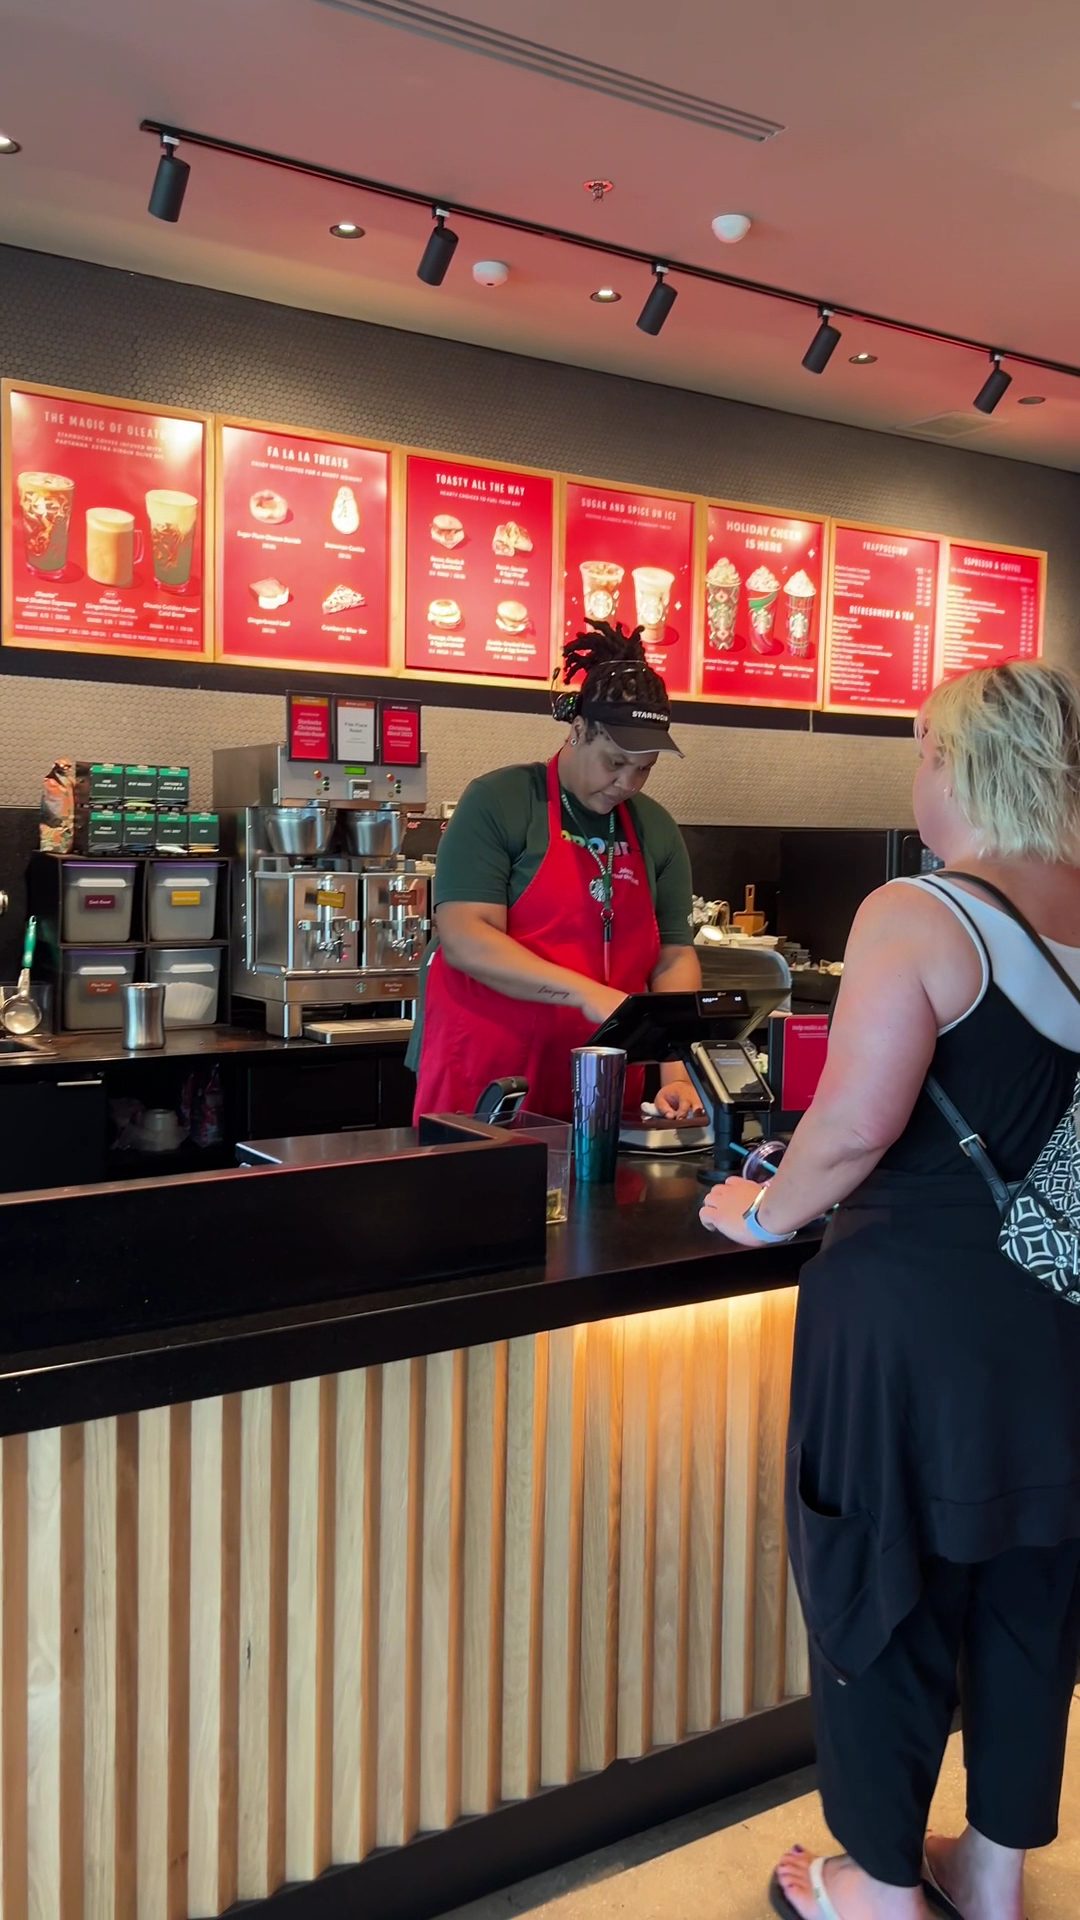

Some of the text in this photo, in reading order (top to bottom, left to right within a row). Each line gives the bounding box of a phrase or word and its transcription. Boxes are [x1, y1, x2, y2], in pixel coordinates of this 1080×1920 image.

[44, 411, 64, 424] THE
[69, 415, 105, 431] MAGIC
[109, 422, 122, 433] OF
[112, 447, 134, 455] VIRGIN
[135, 450, 152, 458] OLIVE
[120, 441, 145, 450] INFUSED
[267, 446, 349, 469] FA LA LA TREATS
[285, 466, 304, 474] COFFEE
[436, 473, 525, 496] TOASTY ALL THE WAY
[439, 490, 458, 498] HEARTY
[458, 493, 479, 501] CHOICES
[581, 497, 677, 521] SUGAR AND SPICE ON ICE
[726, 520, 769, 536] HOLIDAY
[745, 537, 782, 553] IS HERE
[964, 557, 1021, 574] ESPRESSO & COFFEE
[849, 605, 914, 621] REFRESHMENT & TEA
